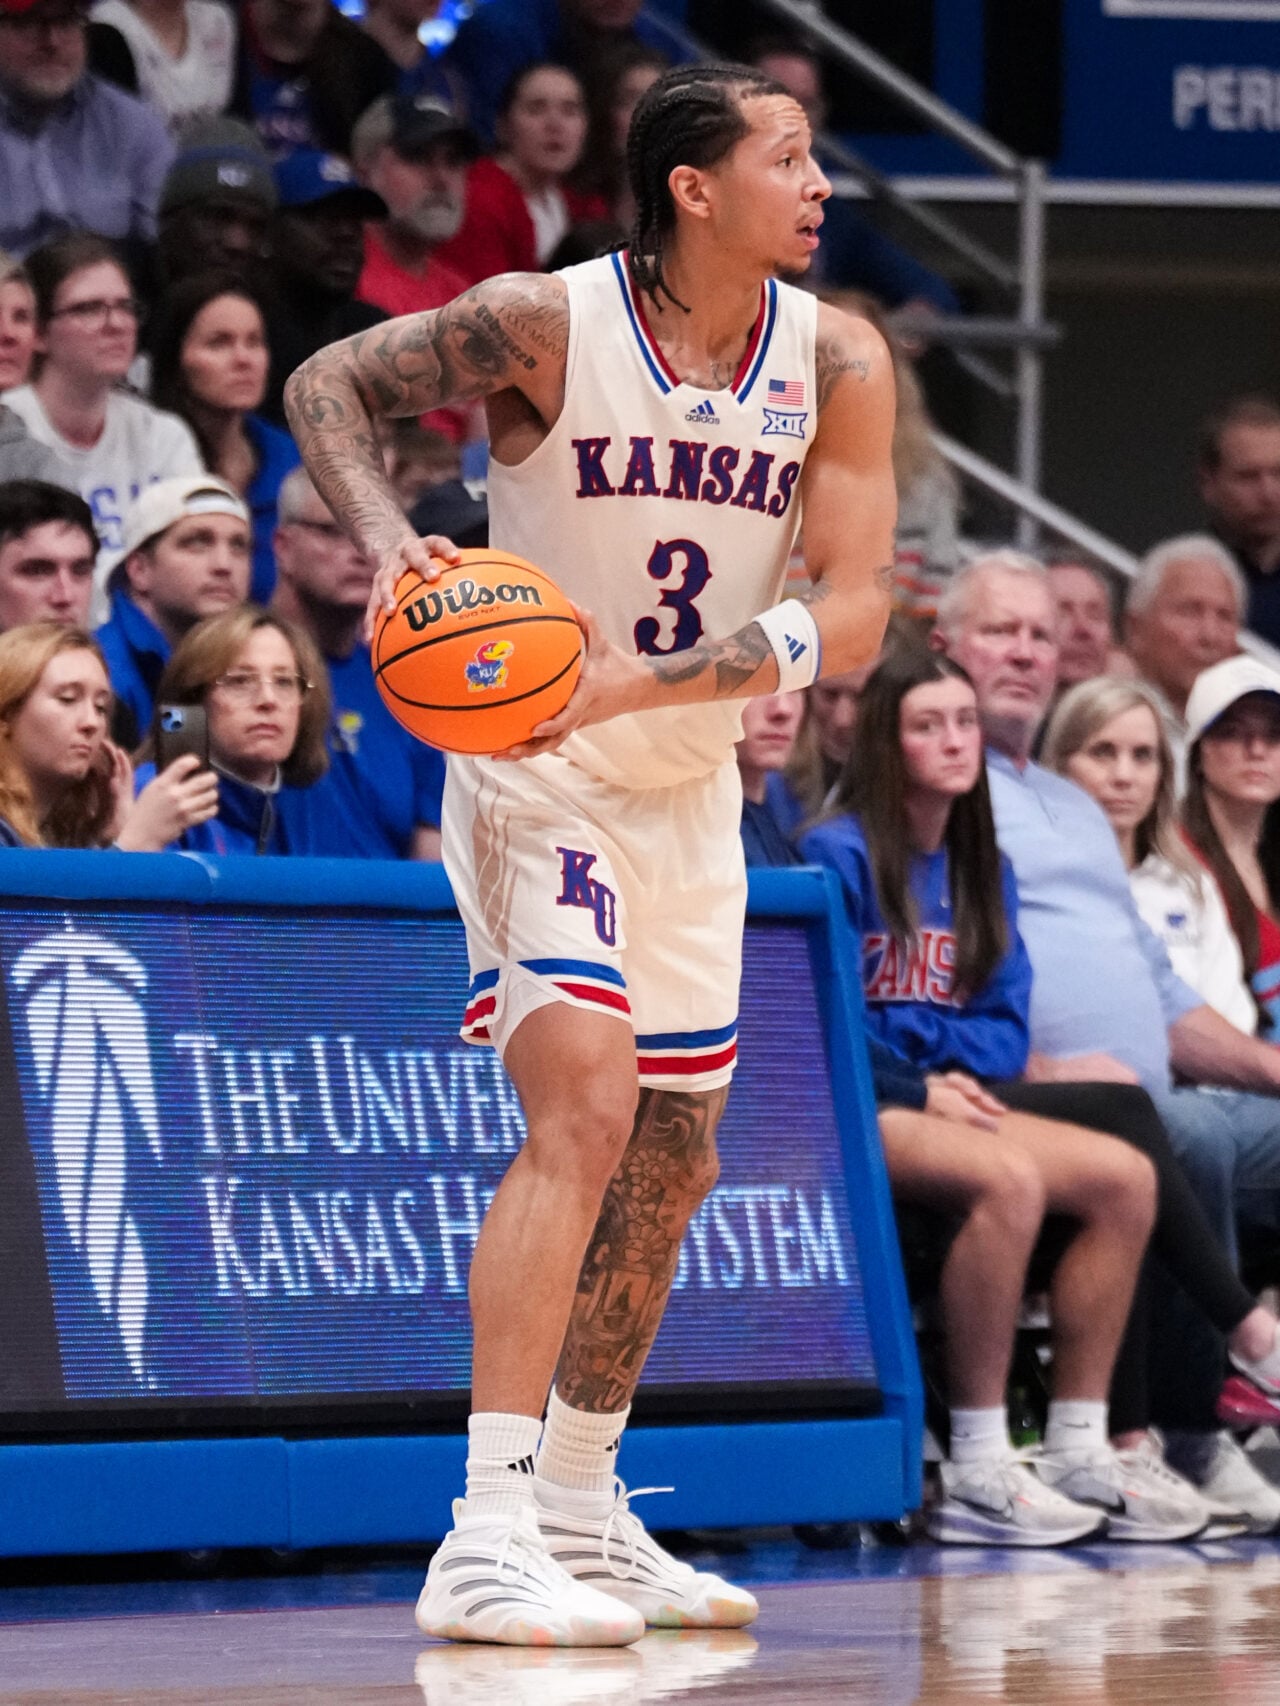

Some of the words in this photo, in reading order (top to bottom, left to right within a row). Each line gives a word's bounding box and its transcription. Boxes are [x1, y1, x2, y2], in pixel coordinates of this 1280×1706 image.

[685, 413, 720, 425] adidas
[571, 436, 800, 518] KANSAS
[402, 580, 542, 631] Wilson
[634, 538, 712, 656] 3
[555, 846, 617, 948] KU
[201, 1174, 428, 1297] KANSAS
[672, 1184, 850, 1290] YSTEM
